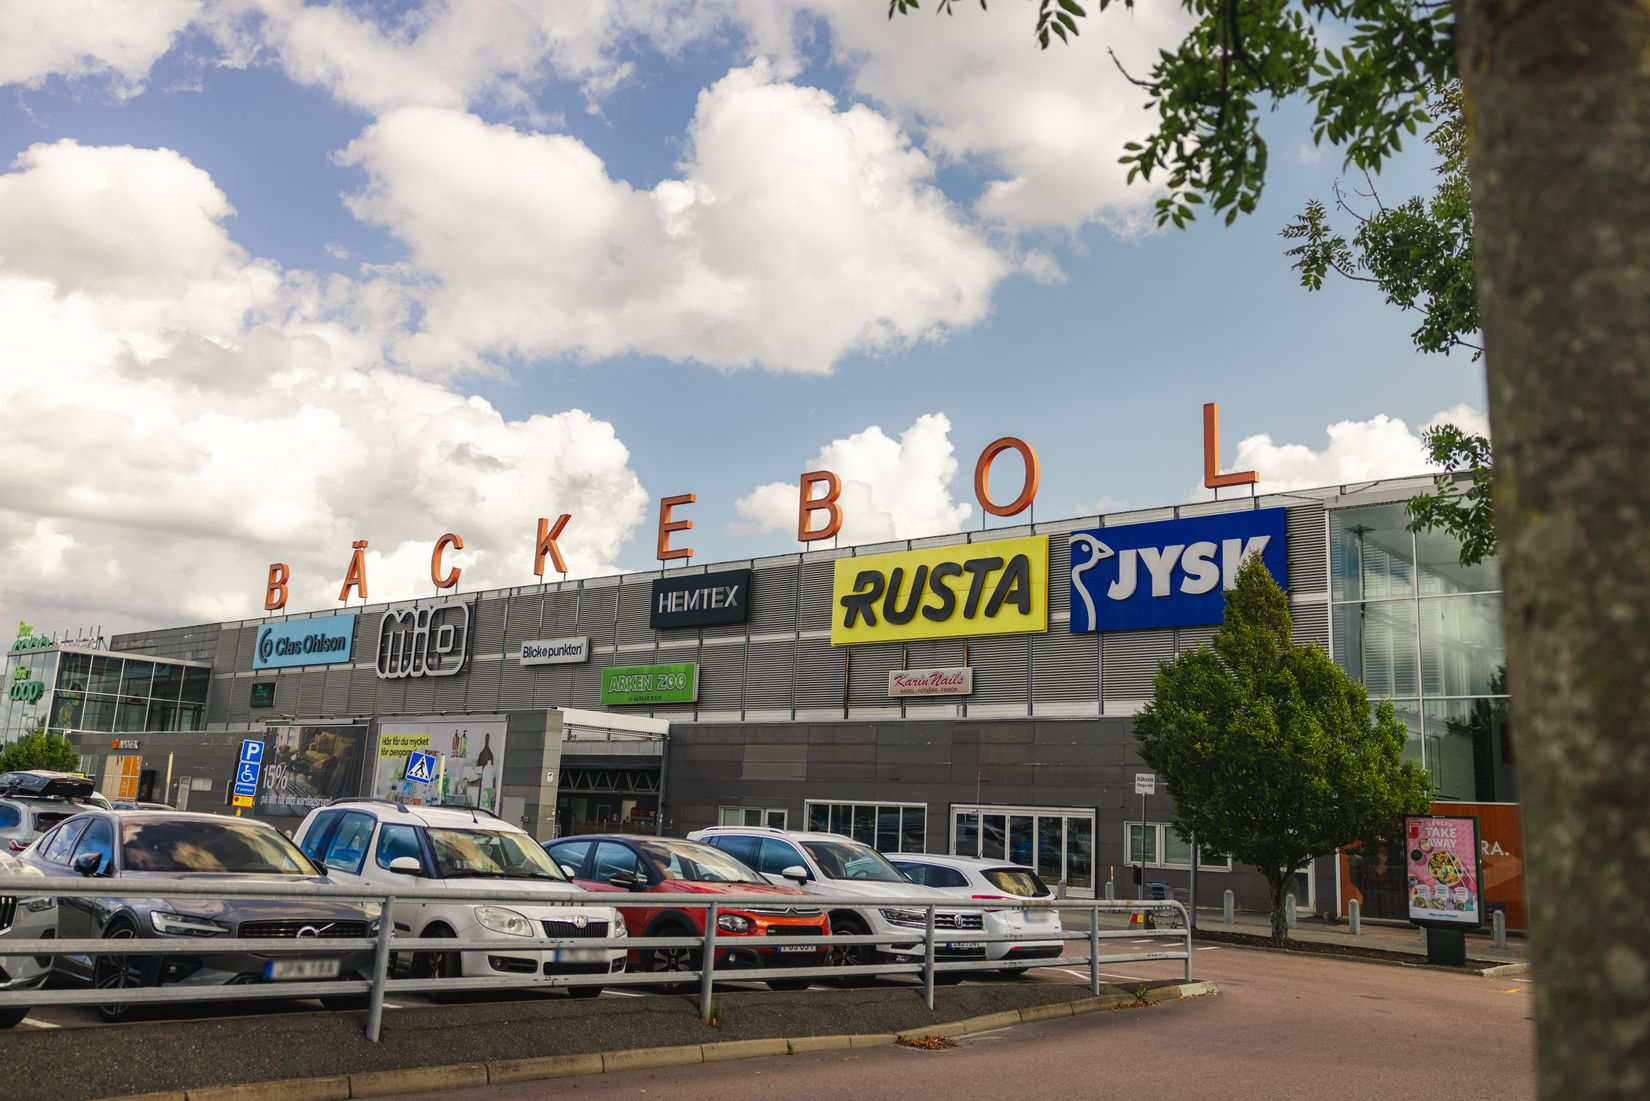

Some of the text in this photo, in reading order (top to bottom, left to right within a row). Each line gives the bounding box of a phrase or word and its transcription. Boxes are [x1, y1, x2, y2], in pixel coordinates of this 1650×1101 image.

[1107, 535, 1272, 601] JYSK
[658, 585, 739, 613] HEMTEX
[840, 553, 1030, 629] RUSTA
[275, 633, 346, 656] Clas Ohlson
[608, 672, 687, 692] ARKEN ZOO
[894, 671, 965, 687] Karin Nails
[8, 681, 44, 705] coop
[246, 743, 260, 760] P
[409, 737, 429, 747] mycket
[263, 764, 288, 790] 15%
[1425, 827, 1457, 838] TAKE
[1426, 838, 1457, 848] AWAY
